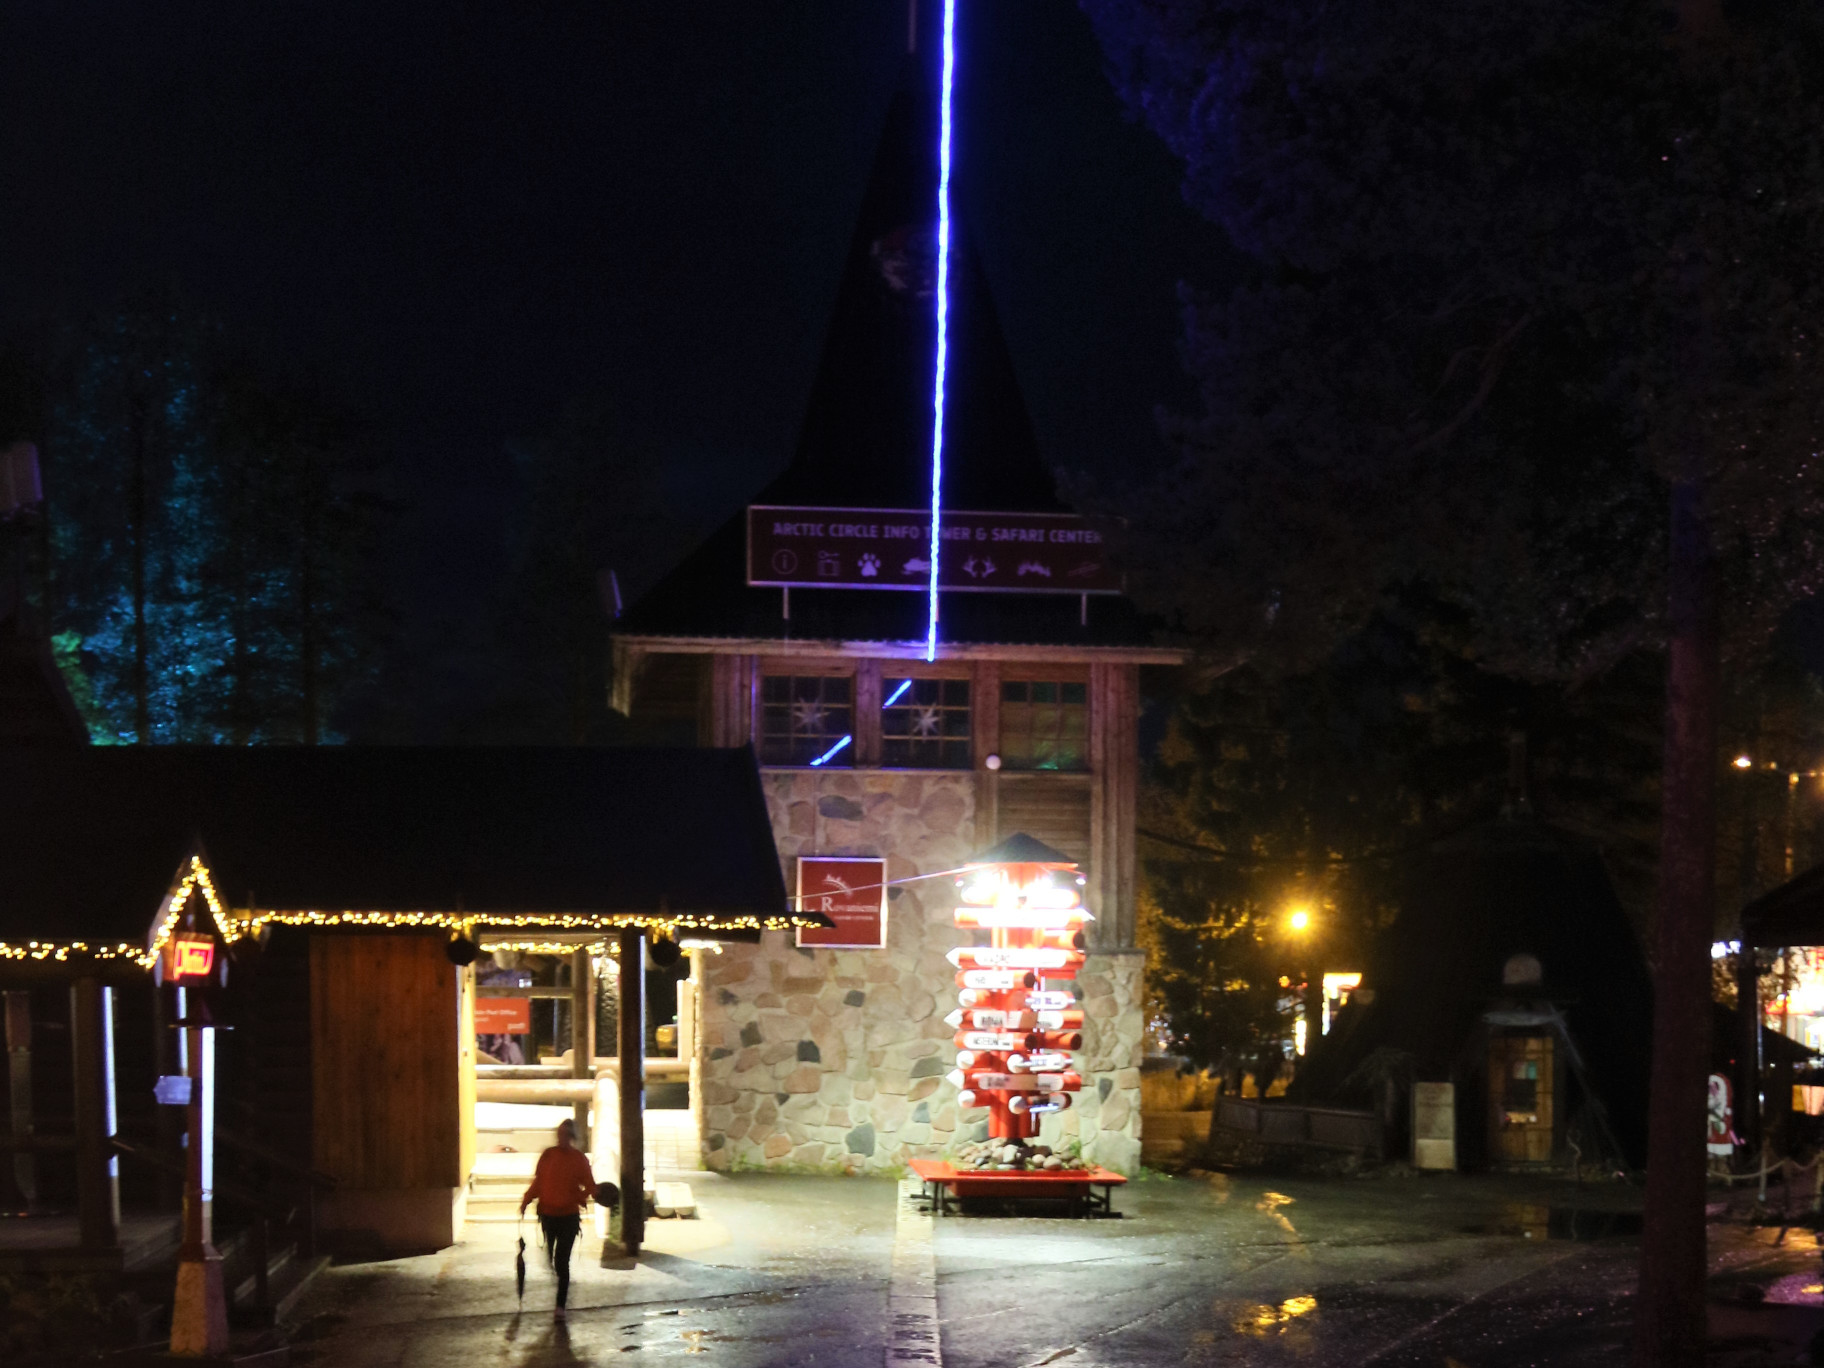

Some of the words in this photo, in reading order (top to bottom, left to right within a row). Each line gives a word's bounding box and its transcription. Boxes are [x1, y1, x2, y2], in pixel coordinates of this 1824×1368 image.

[772, 521, 826, 537] ARCTIC
[828, 523, 879, 539] CIRCLE
[883, 525, 920, 540] INFO
[924, 526, 972, 541] TWER
[975, 527, 988, 542] &
[991, 528, 1046, 543] SAFARI
